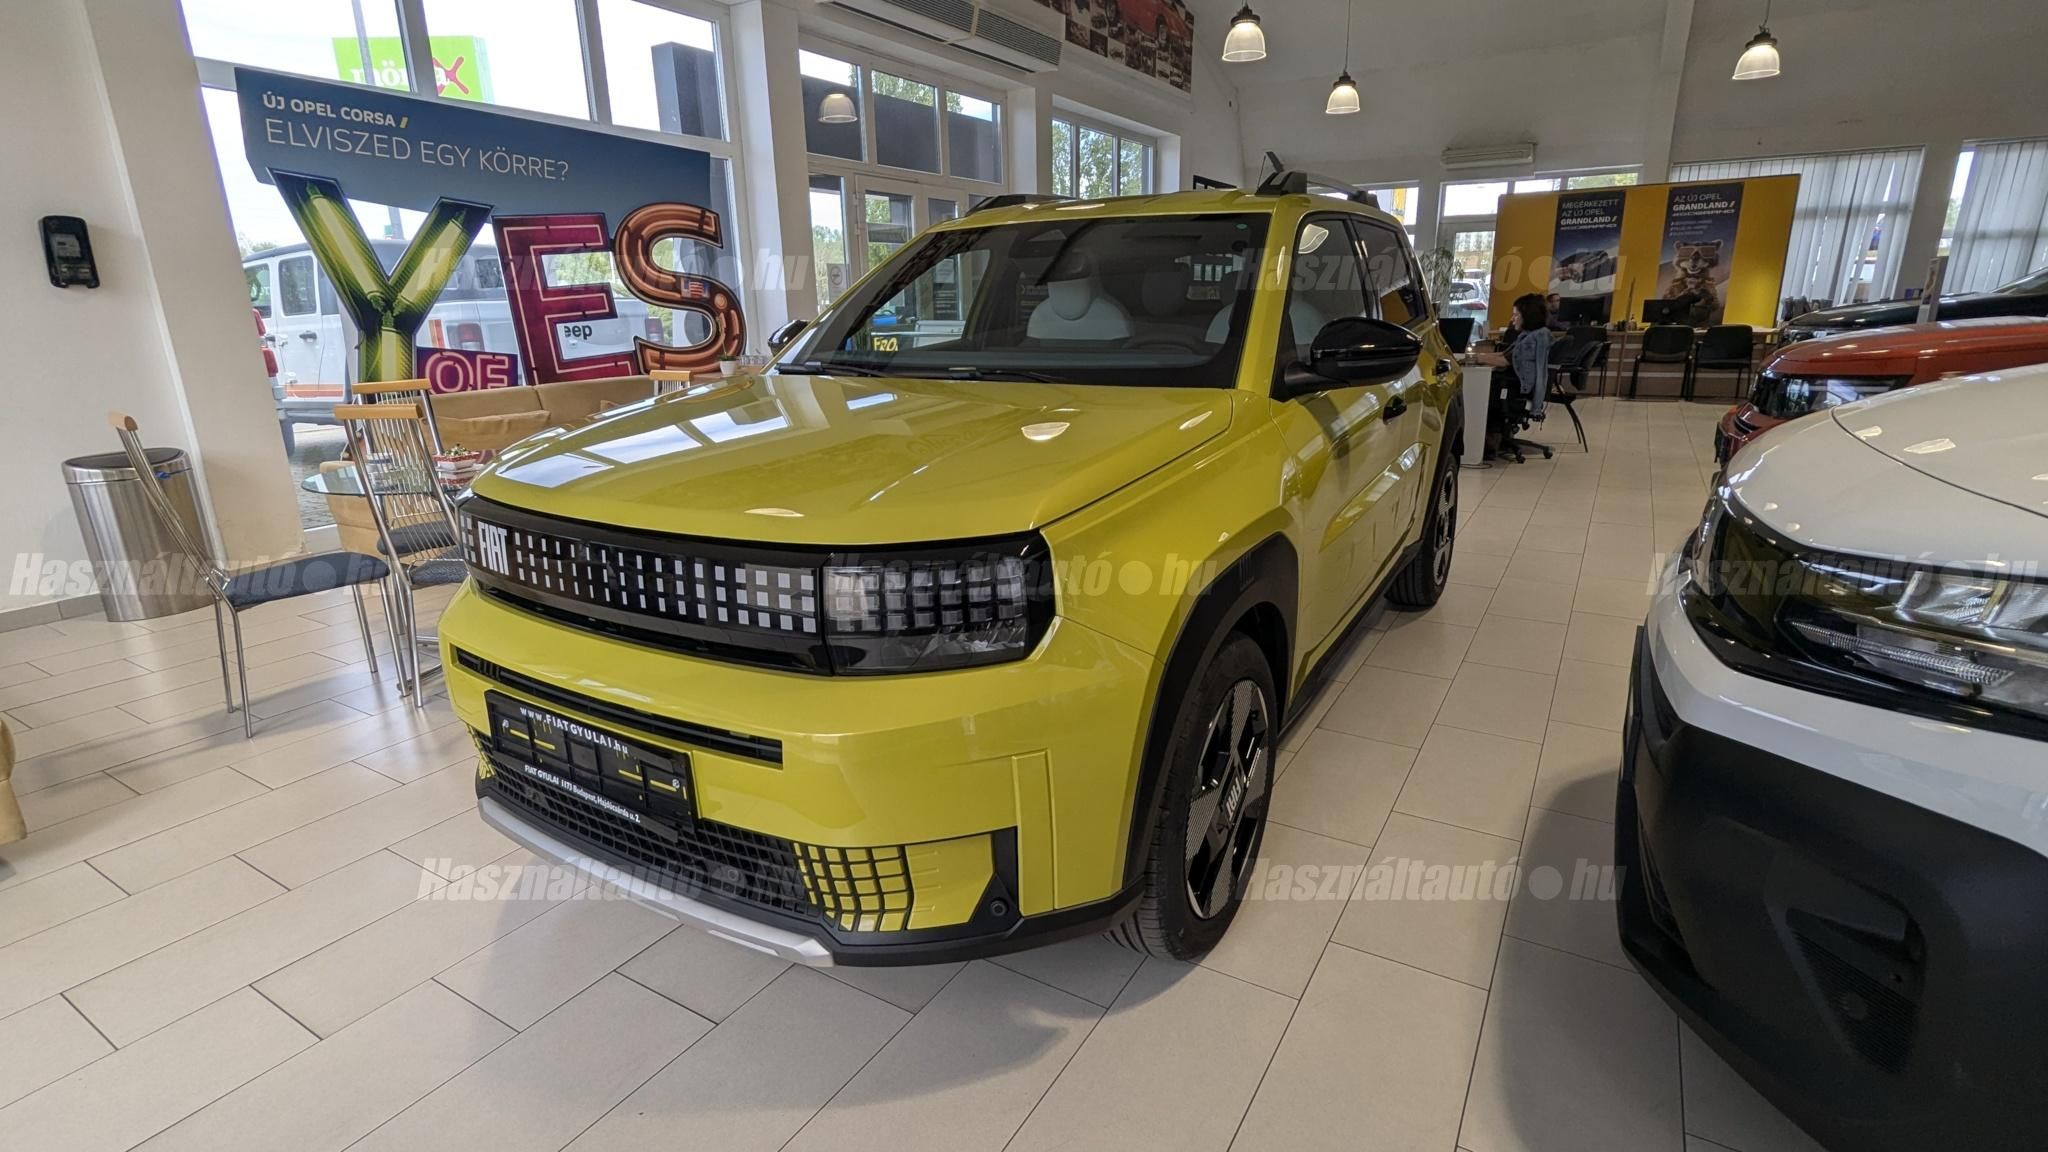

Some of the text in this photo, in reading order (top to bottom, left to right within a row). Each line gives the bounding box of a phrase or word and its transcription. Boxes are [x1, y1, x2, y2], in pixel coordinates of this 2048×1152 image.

[262, 91, 396, 127] ÚJ OPEL CORSA
[265, 118, 569, 181] ELVISZED EGY KÖRRE?
[1672, 201, 1728, 212] GRANDLAND
[1699, 192, 1722, 201] OPEL
[1560, 216, 1612, 226] GRANDLAND
[1584, 208, 1605, 216] OPEL
[267, 167, 747, 388] YES
[563, 325, 592, 340] eep
[477, 520, 510, 576] FIAT
[519, 707, 629, 755] www.FIATGYULAI.hu
[524, 764, 538, 776] FIAT
[537, 770, 560, 785] GYULAI
[1226, 776, 1242, 822] FIAT
